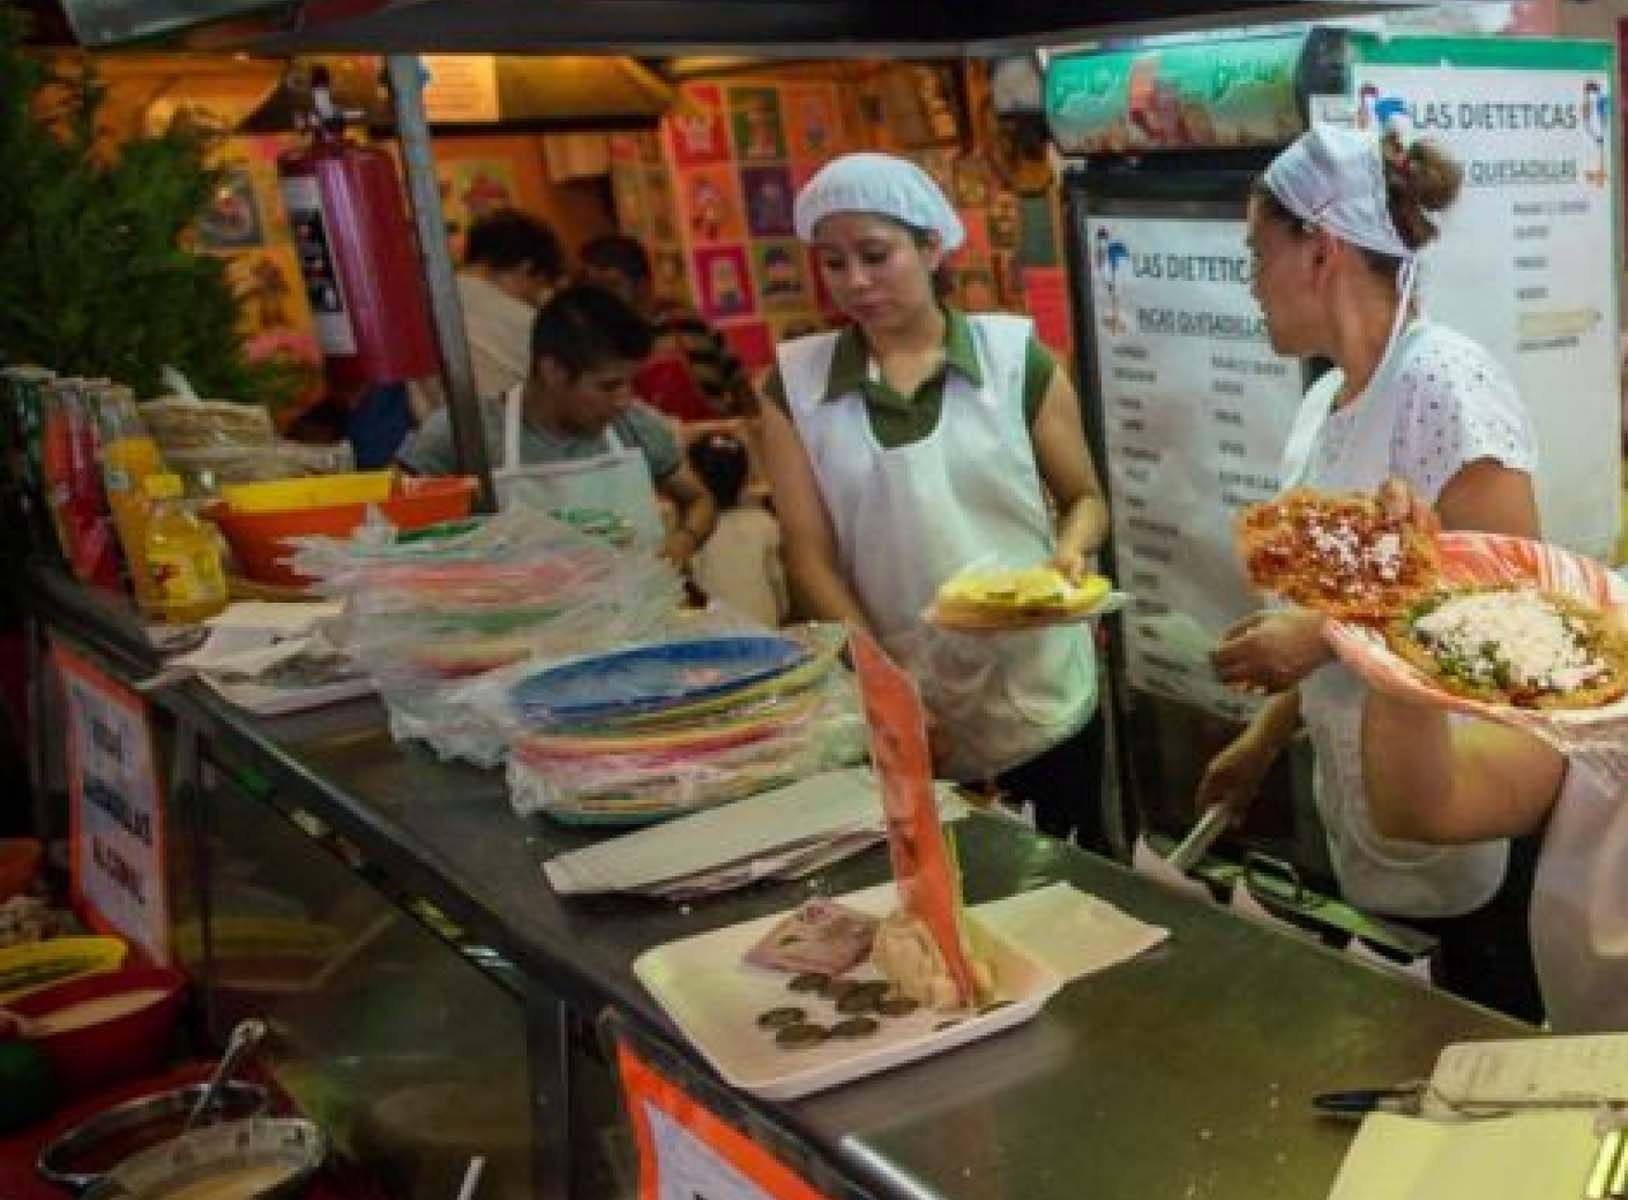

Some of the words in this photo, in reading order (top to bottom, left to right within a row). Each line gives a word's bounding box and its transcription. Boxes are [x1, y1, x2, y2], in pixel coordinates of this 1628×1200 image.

[1413, 103, 1451, 129] LAS
[1459, 103, 1577, 129] DIETETICAS
[1470, 160, 1577, 184] QUESADILLAS
[1133, 254, 1163, 278] LAS
[1166, 255, 1250, 284] DIETETIC
[1176, 309, 1264, 337] QUESADILLA
